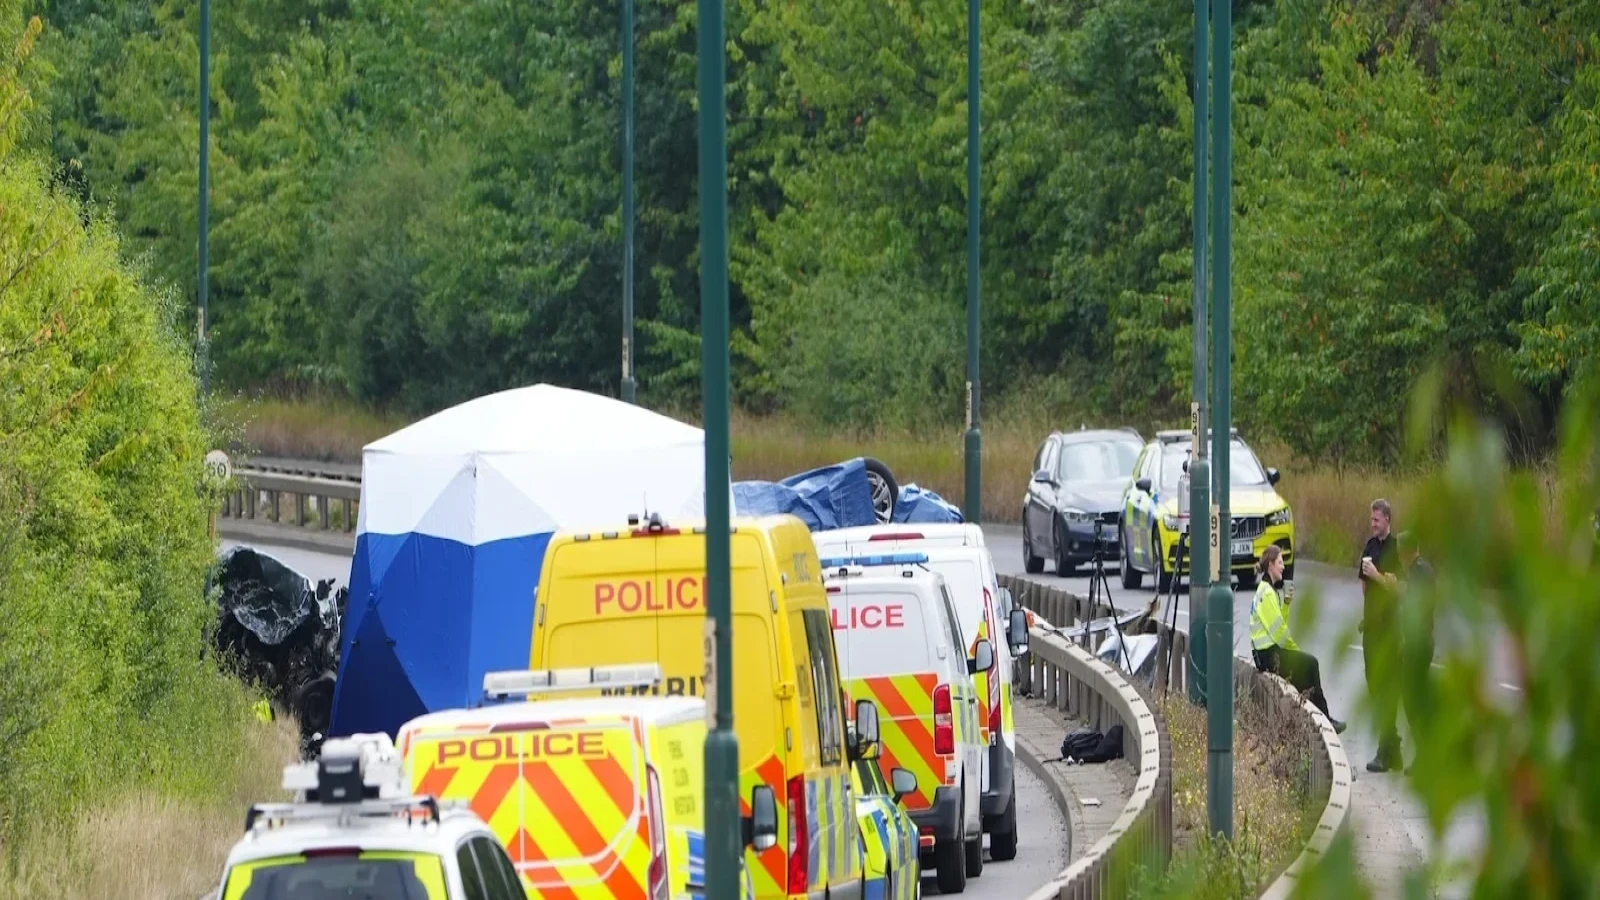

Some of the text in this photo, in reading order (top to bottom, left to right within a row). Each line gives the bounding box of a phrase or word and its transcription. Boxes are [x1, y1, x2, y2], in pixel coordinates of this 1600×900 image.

[1192, 412, 1198, 436] 94
[1210, 515, 1218, 548] 93
[831, 604, 905, 631] LICE
[438, 732, 604, 765] POLICE
